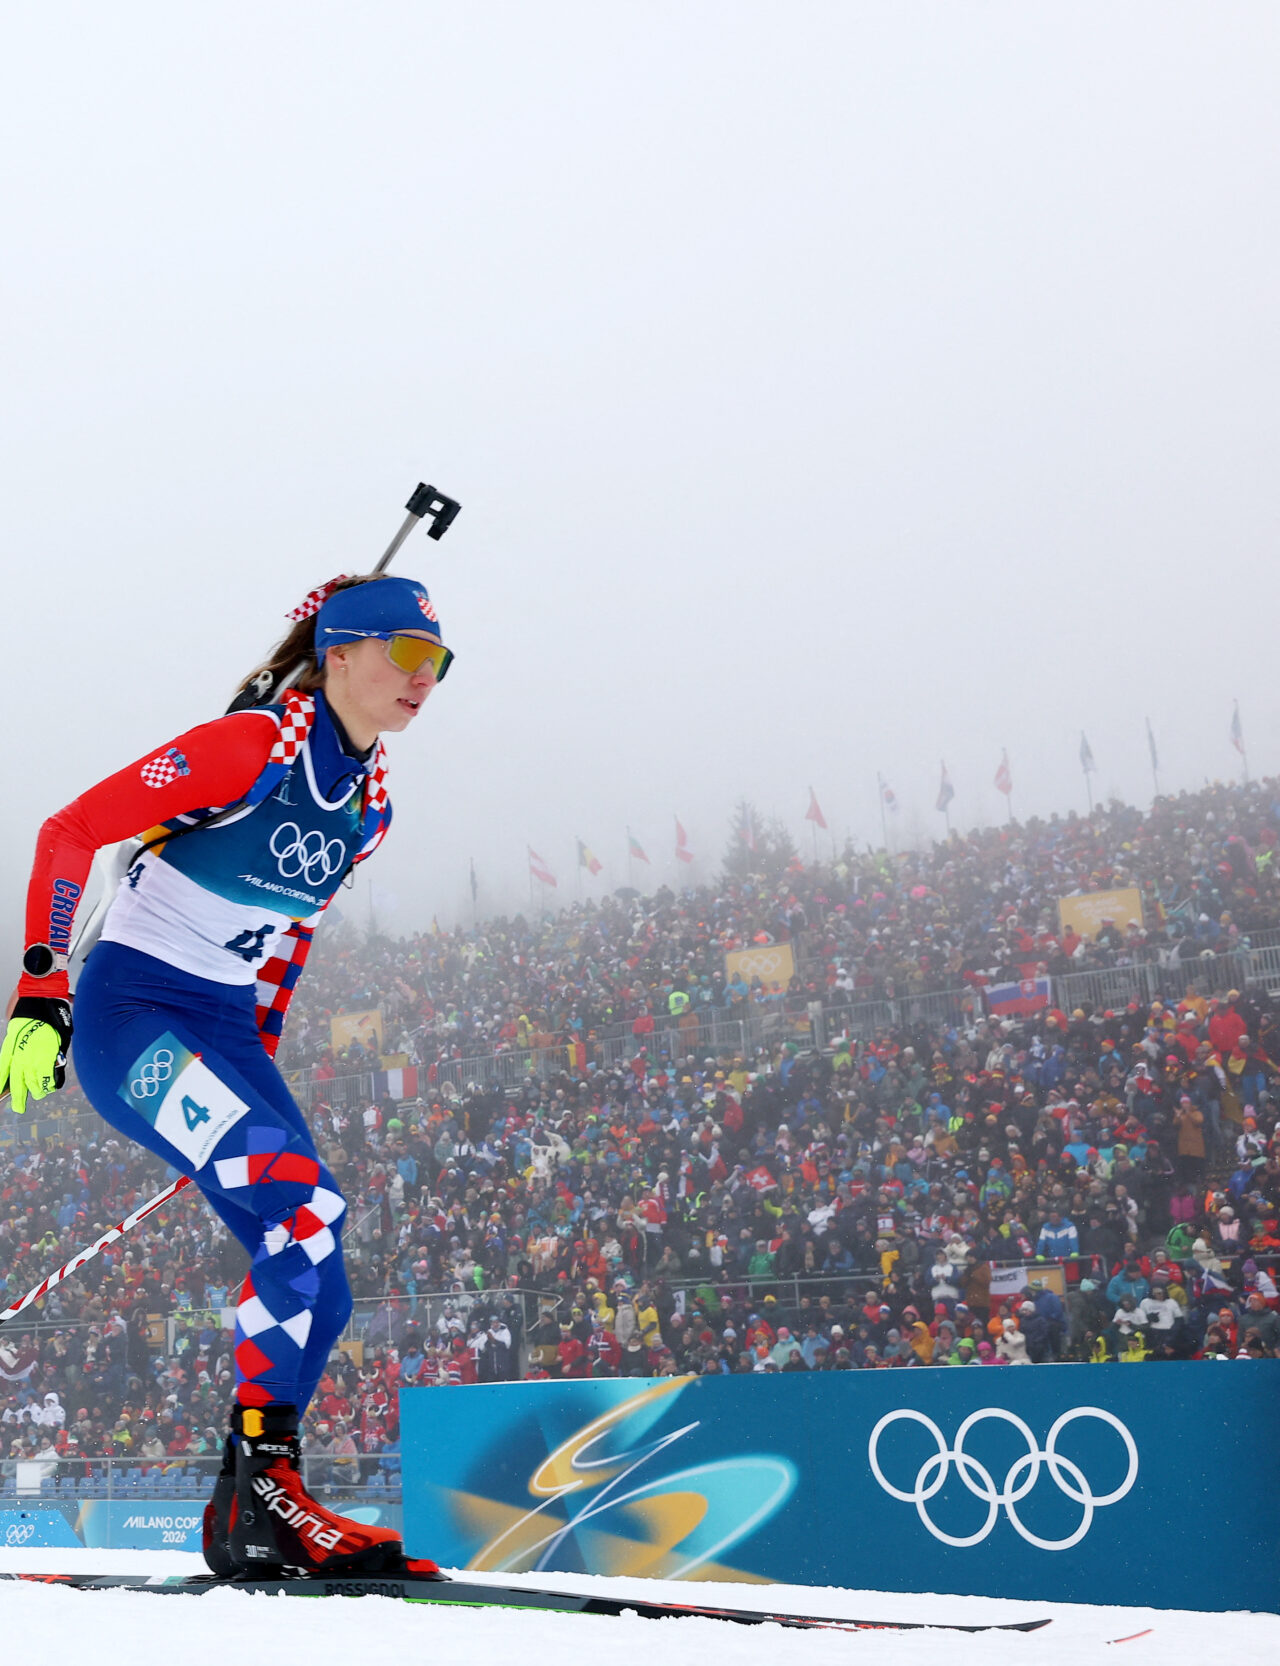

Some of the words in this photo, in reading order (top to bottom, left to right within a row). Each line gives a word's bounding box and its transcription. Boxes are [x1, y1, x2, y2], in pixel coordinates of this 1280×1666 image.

[237, 874, 283, 894] MILANO
[48, 878, 81, 956] CROAT
[224, 923, 276, 963] 4
[181, 1094, 212, 1133] 4
[122, 1516, 173, 1529] MILANO
[251, 1476, 344, 1551] alpina
[162, 1530, 187, 1543] 2026
